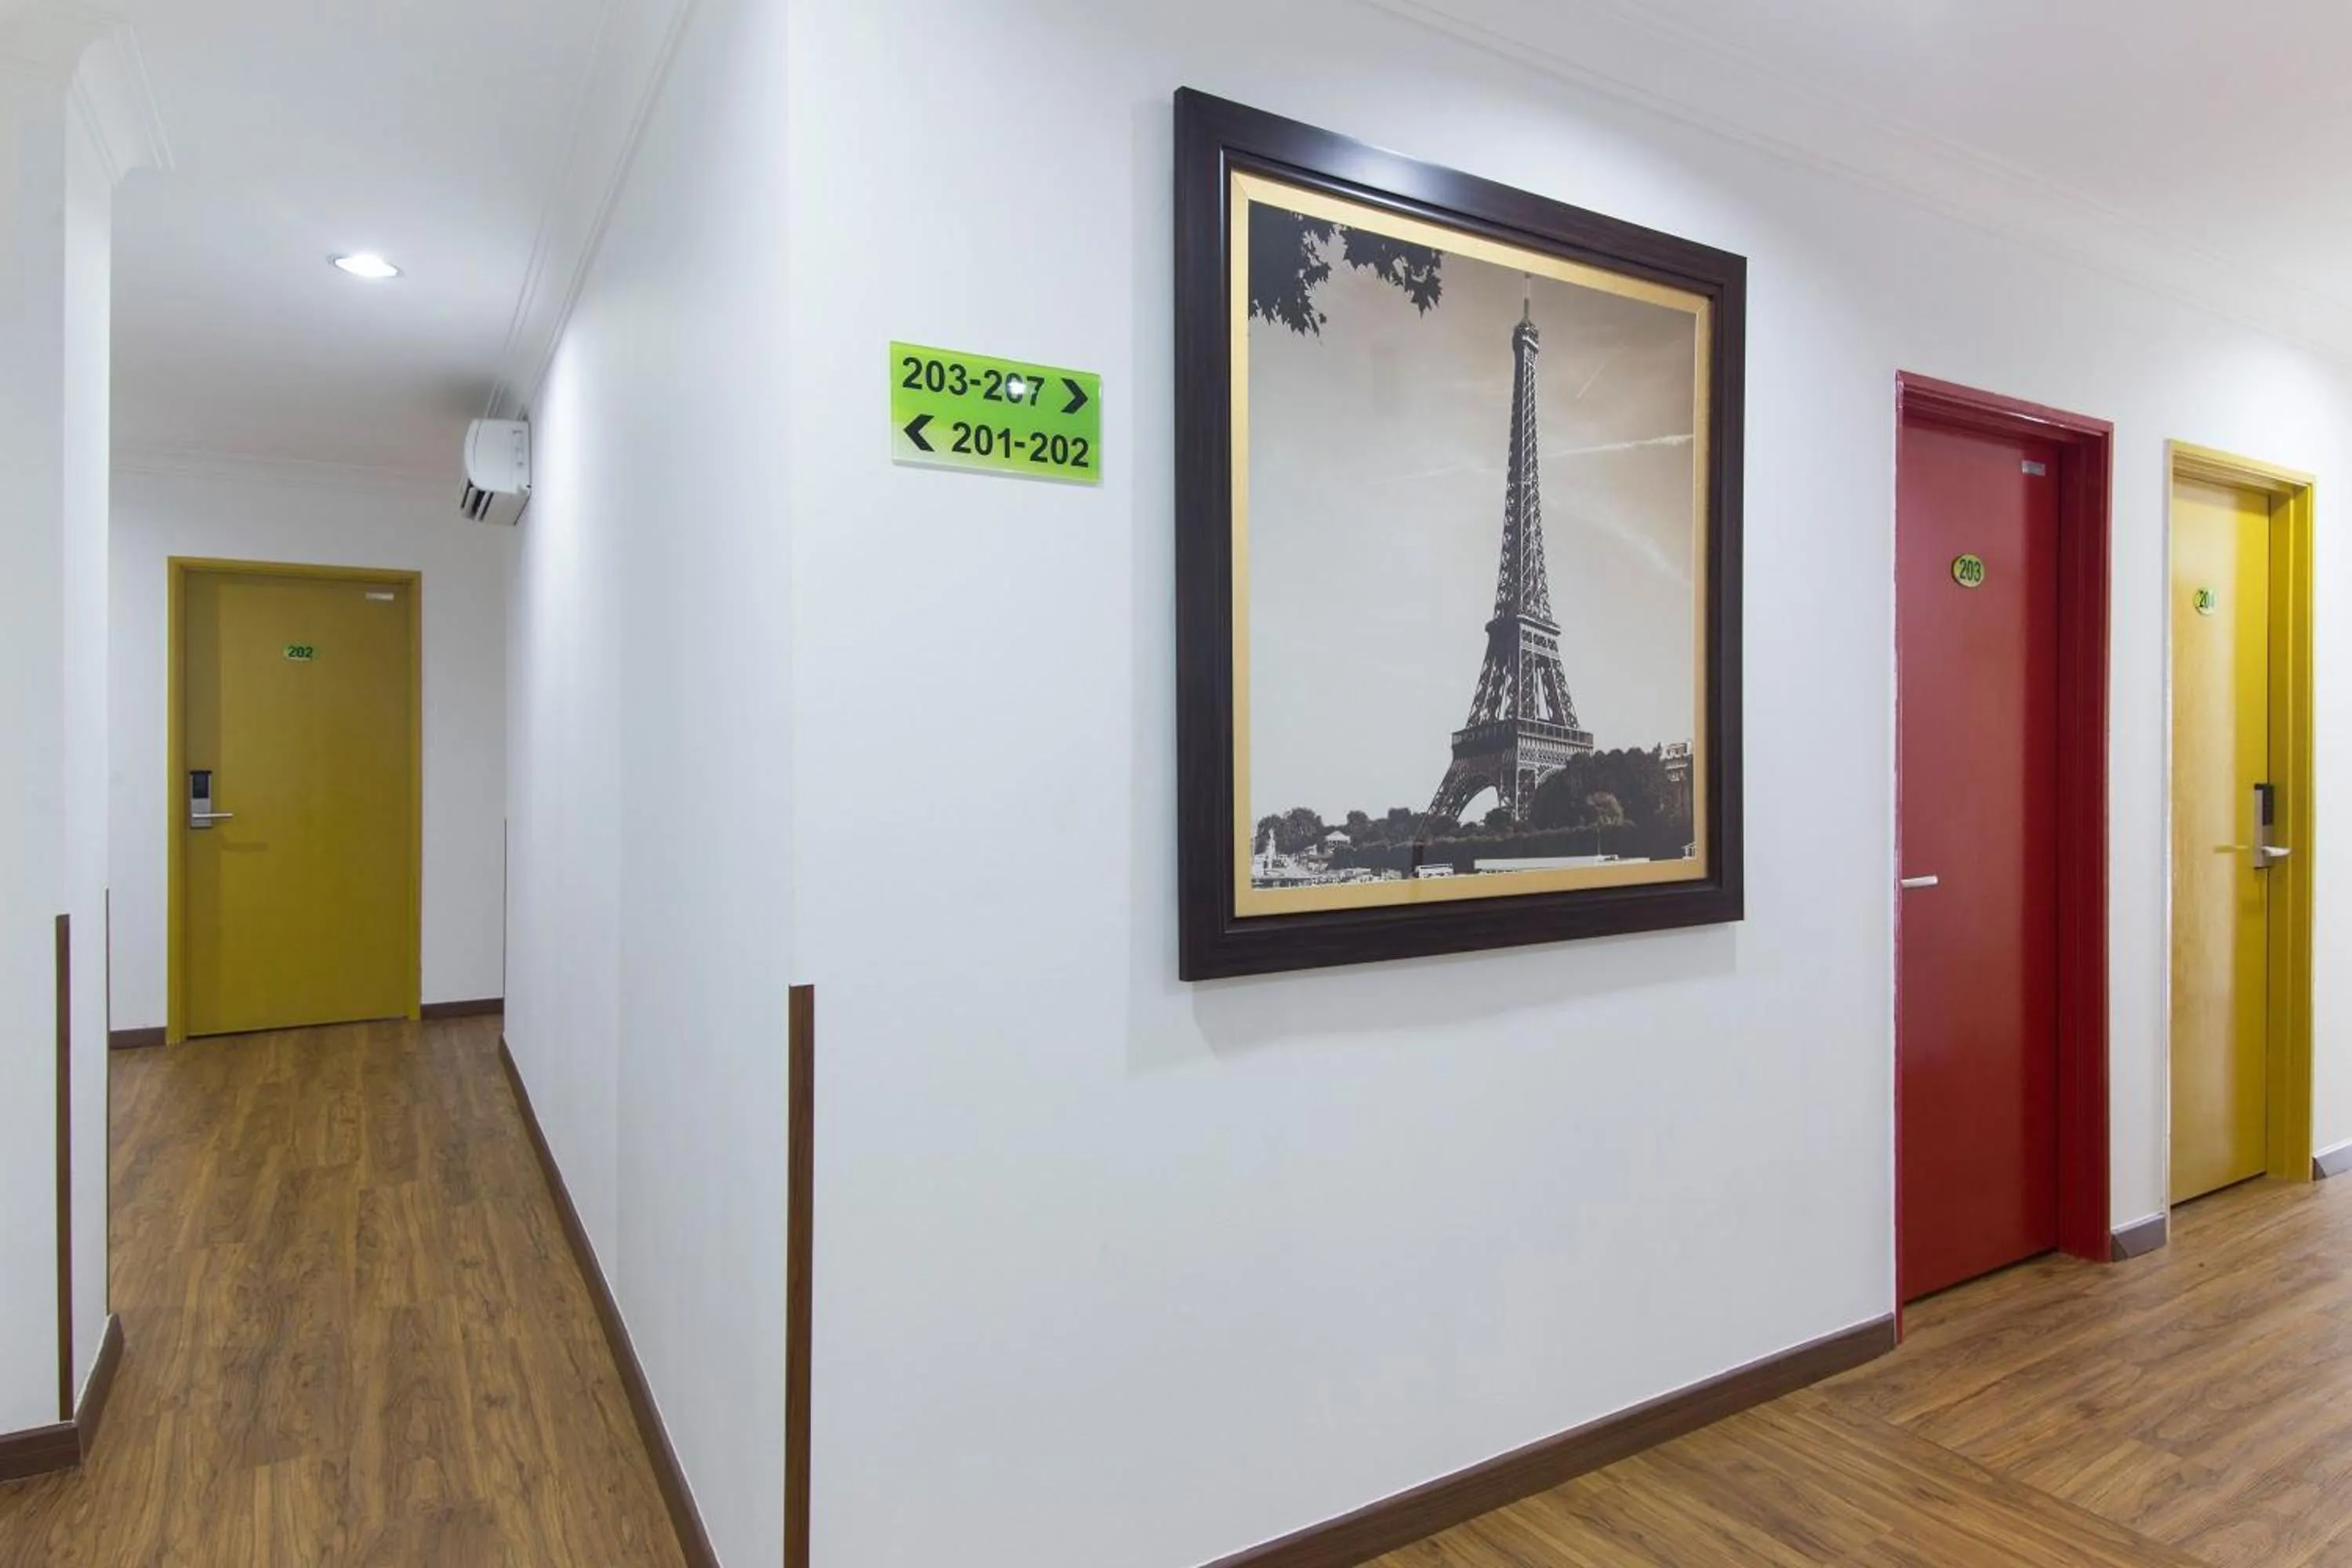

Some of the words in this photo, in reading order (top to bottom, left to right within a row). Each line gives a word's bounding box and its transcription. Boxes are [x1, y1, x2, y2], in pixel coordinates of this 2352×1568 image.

[902, 358, 1045, 406] 203-207
[952, 422, 1089, 468] 201-202
[1959, 558, 1981, 582] 203
[288, 646, 313, 658] 202
